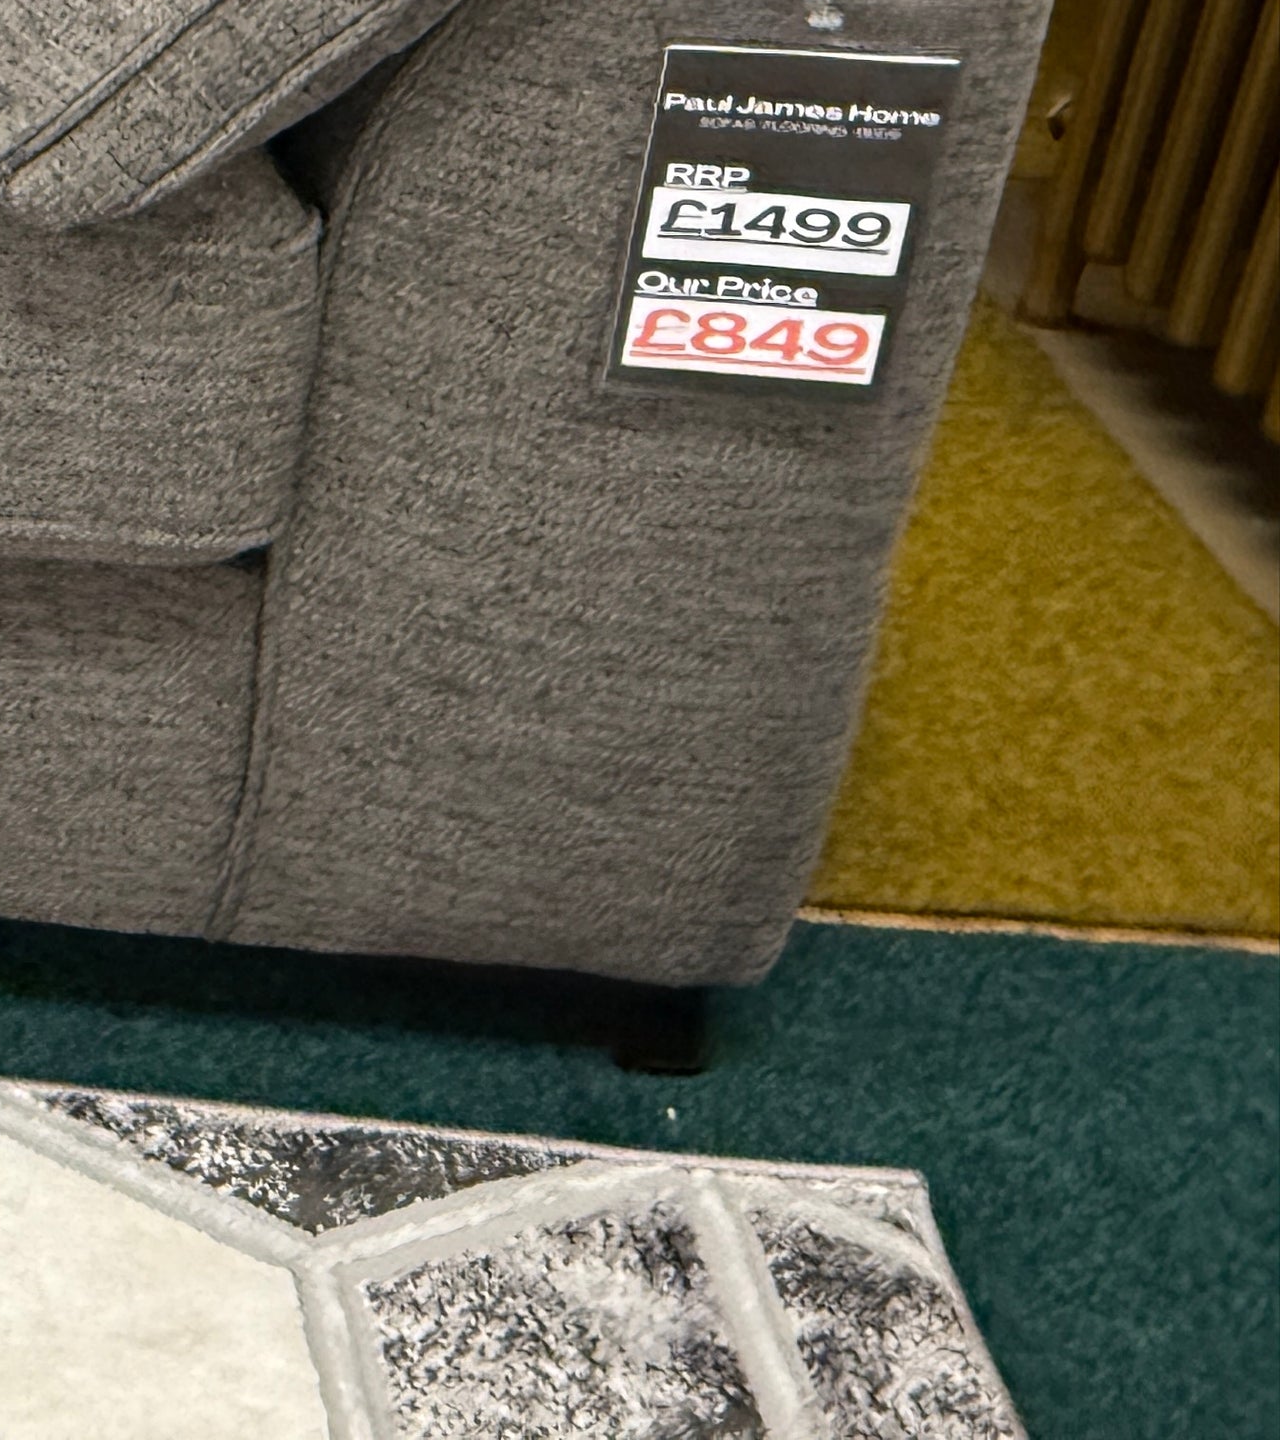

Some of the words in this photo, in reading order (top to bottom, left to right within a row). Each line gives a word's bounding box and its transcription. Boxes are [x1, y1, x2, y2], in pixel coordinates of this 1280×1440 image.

[663, 92, 734, 114] Paul
[735, 96, 844, 121] James
[848, 104, 941, 127] Home
[664, 163, 751, 189] RRP
[659, 199, 892, 249] £1499
[637, 270, 711, 296] Our
[716, 275, 819, 305] Price
[632, 309, 869, 366] £849
